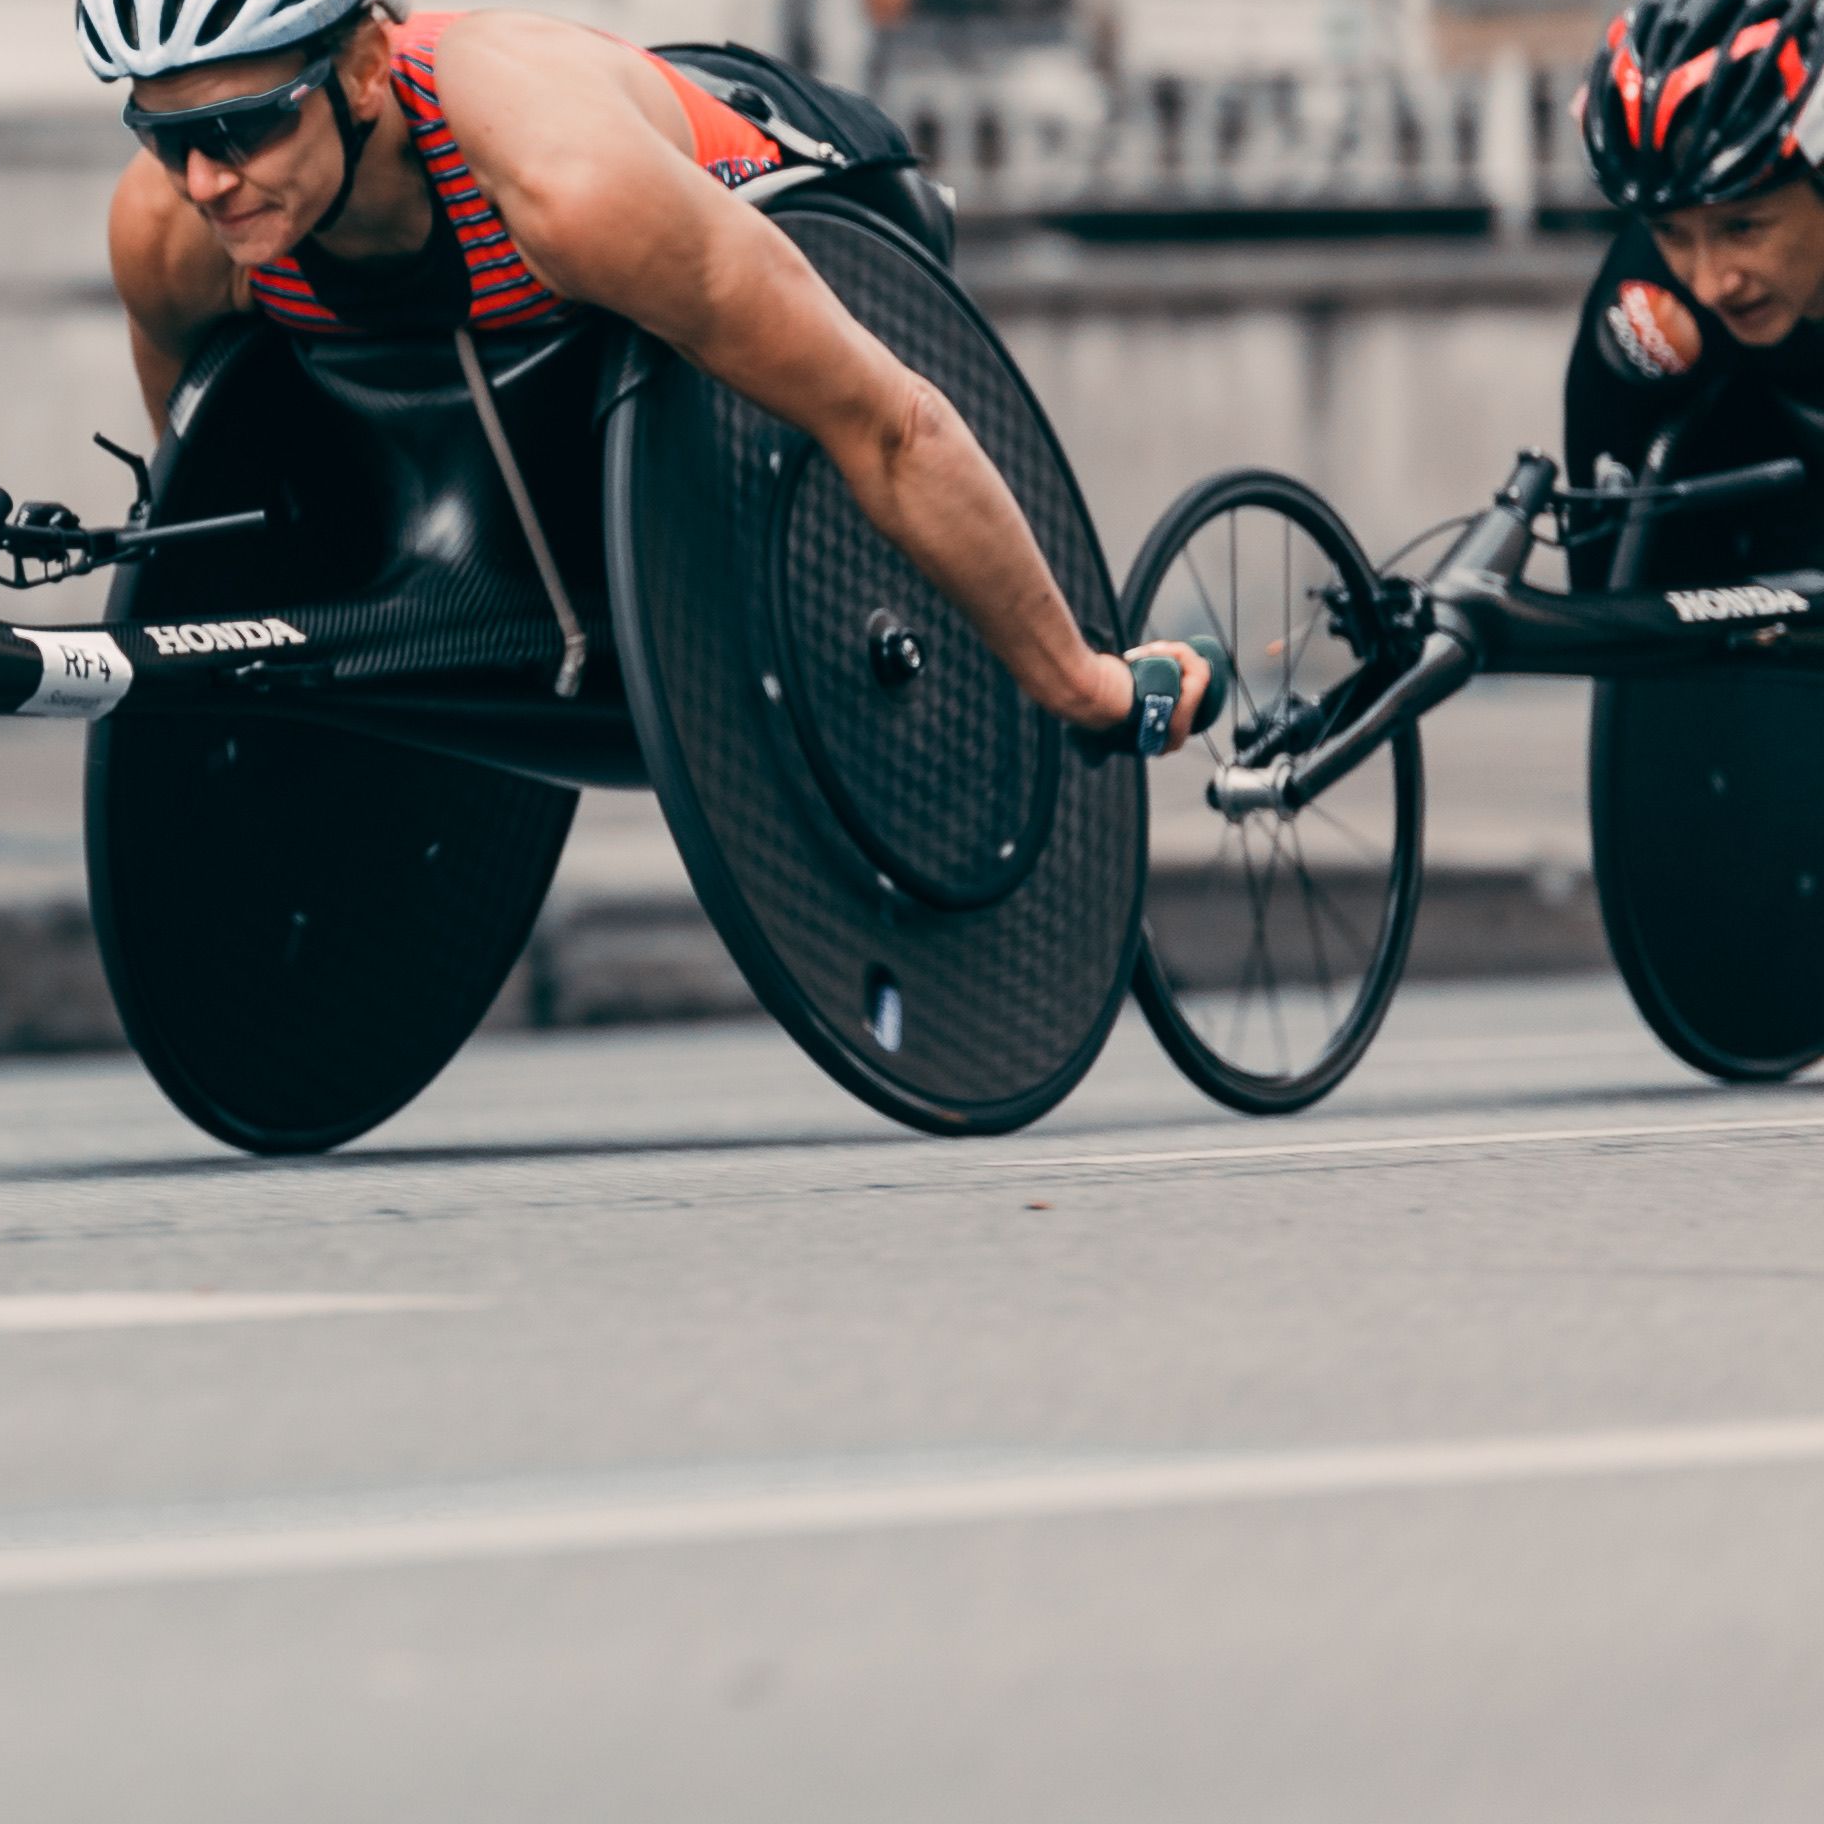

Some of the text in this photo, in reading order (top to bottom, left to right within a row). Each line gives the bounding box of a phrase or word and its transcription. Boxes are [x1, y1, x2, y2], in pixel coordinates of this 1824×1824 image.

[1664, 585, 1811, 623] HONDA
[144, 618, 307, 655] HONDA
[58, 643, 112, 683] RF4
